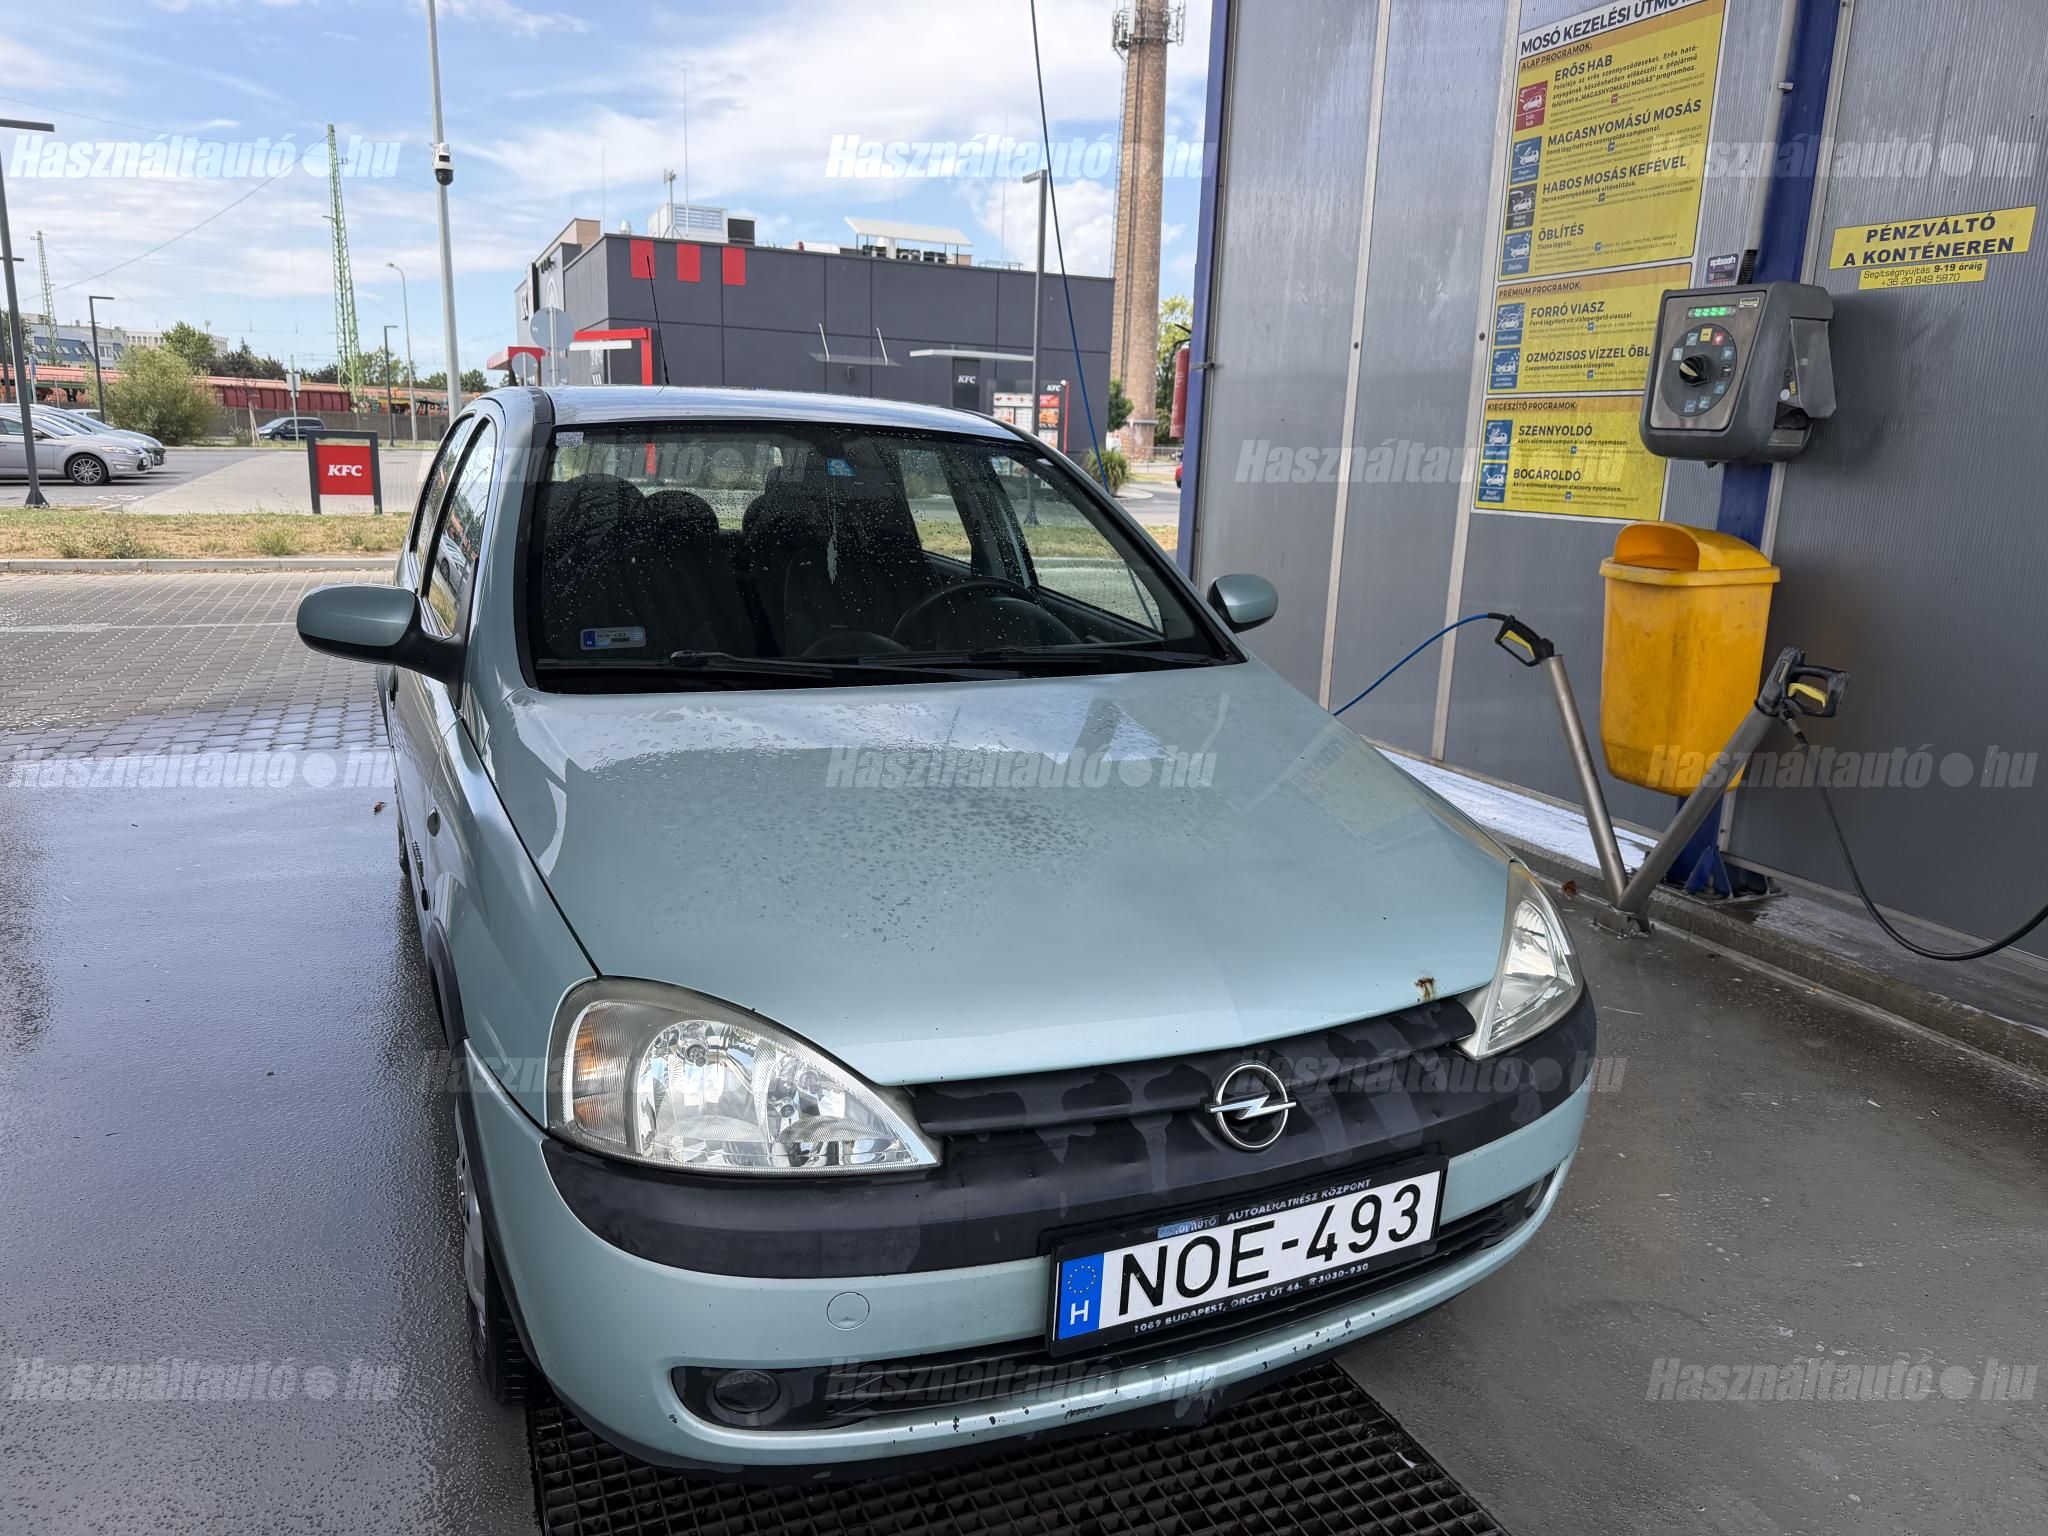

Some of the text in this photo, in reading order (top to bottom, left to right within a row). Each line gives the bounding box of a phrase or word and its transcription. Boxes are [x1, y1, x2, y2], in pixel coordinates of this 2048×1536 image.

[1520, 28, 1560, 55] MOSÓ
[1563, 6, 1630, 42] KEZELÉSI
[1521, 42, 1593, 71] ALAP PROGRAMOK:
[1554, 54, 1613, 82] ERŐS HAB
[1547, 108, 1651, 147] MAGASNYOMÁSÚ
[1653, 98, 1702, 122] MOSÁS
[1542, 176, 1582, 194] HABOS
[1583, 165, 1627, 186] MOSÁS
[1629, 156, 1687, 178] KEFÉVEL
[1538, 222, 1585, 241] ÖBLÍTÉS
[1866, 213, 1996, 243] PÉNZVÁLTÓ
[1843, 237, 2014, 266] A KONTÉNEREN
[1934, 263, 1956, 273] 9-19
[1958, 261, 1983, 272] óráig
[1881, 278, 1898, 287] +36
[1900, 277, 1912, 285] 20
[1936, 273, 1960, 283] 5870
[1498, 286, 1531, 298] PRÉMIUM
[1530, 301, 1605, 319] FORRÓ VIASZ
[1526, 347, 1586, 363] OZMÓZISOS
[1589, 346, 1626, 360] VÍZZEL
[957, 374, 976, 384] KFC
[1487, 401, 1527, 411] KIEGÉSZÍTŐ
[1518, 422, 1593, 436] SZENNYOLDÓ
[327, 464, 362, 477] KFC
[1513, 467, 1581, 481] BOGÁROLDÓ
[1321, 1179, 1371, 1199] KÖZPONT
[1118, 1183, 1421, 1316] NOE-493
[1069, 1299, 1089, 1325] H
[1165, 1302, 1228, 1325] BUDAPEST,
[1230, 1291, 1267, 1308] ORCZY
[1270, 1286, 1284, 1297] ÚT
[1287, 1282, 1303, 1293] 46.
